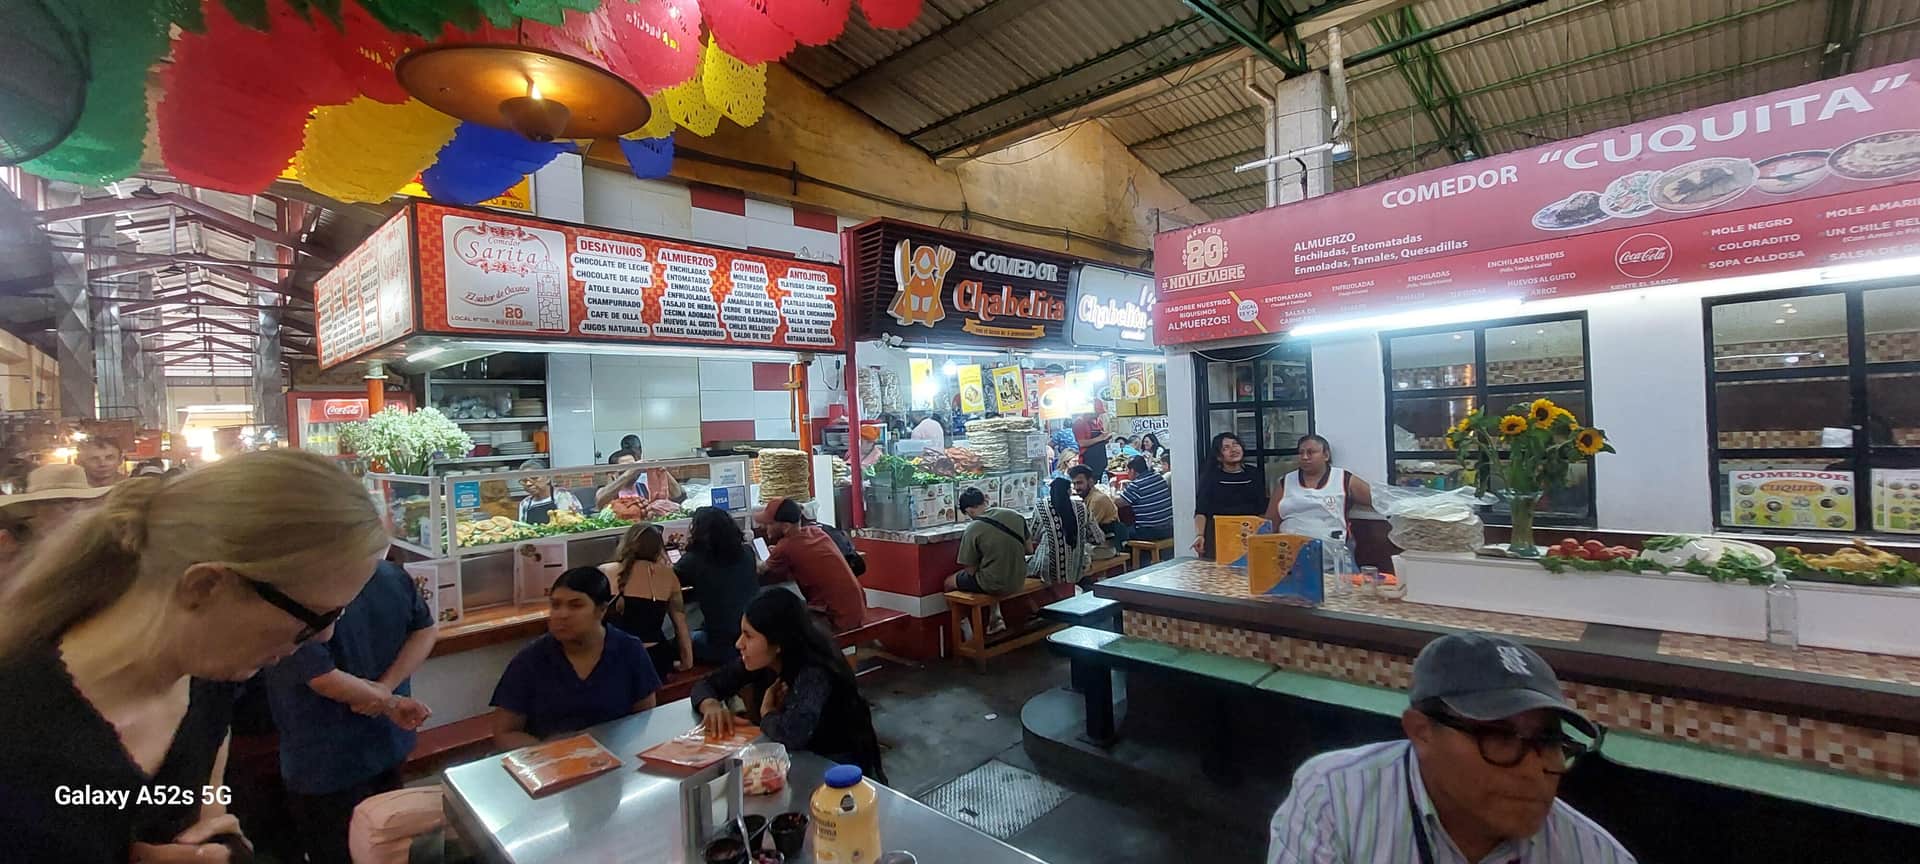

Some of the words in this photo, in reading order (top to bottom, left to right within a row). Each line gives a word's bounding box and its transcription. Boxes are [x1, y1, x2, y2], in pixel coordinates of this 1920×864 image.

[1382, 165, 1519, 209] COMEDOR
[1826, 206, 1865, 219] MOLE
[1187, 226, 1222, 240] MERCADO
[1712, 224, 1745, 236] MOLE
[1748, 218, 1792, 231] NEGRO
[1826, 227, 1846, 238] UN
[1850, 220, 1892, 234] CHILE
[1294, 232, 1356, 253] ALMUERZO
[1294, 248, 1349, 264] Enchiladas,
[1352, 233, 1422, 254] Entomatadas
[1718, 233, 1801, 252] COLORADITO
[465, 241, 536, 265] Sarita
[580, 240, 642, 258] DESAYUNOS
[1186, 235, 1223, 271] 20
[660, 252, 714, 268] ALMUERZOS
[1294, 260, 1350, 276] Enmoladas,
[1352, 252, 1399, 267] Tamales,
[1401, 240, 1469, 258] Quesadillas
[1487, 256, 1534, 268] ENCHILADAS
[1535, 251, 1565, 263] VERDES
[1618, 246, 1669, 266] Coca-Cola
[1708, 258, 1740, 270] SOPA
[1744, 250, 1806, 264] CALDOSA
[574, 256, 616, 269] CHOCOLATE
[618, 262, 626, 270] DE
[628, 264, 649, 273] LECHE
[734, 262, 765, 274] COMIDA
[970, 250, 1058, 282] COMEDOR
[670, 266, 707, 276] ENCHILADAS
[790, 270, 826, 282] ANTOJITOS
[1408, 270, 1450, 282] ENCHILADAS
[576, 270, 617, 282] CHOCOLATE
[619, 274, 628, 282] DE
[630, 276, 649, 285] AGUA
[666, 274, 710, 285] ENTOMATADAS
[733, 274, 748, 282] MOLE
[749, 275, 767, 284] NEGRO
[1170, 266, 1246, 290] NOVIEMBRE
[1508, 277, 1538, 288] HUEVOS
[1539, 276, 1548, 284] AL
[1550, 272, 1576, 282] GUSTO
[588, 284, 610, 294] ATOLE
[612, 286, 640, 296] BLANCO
[670, 283, 707, 293] ENMOLADAS
[736, 282, 764, 292] ESTOFADO
[668, 292, 711, 302] ENFRIJOLADAS
[734, 290, 767, 300] COLORADITO
[953, 280, 1064, 322] Chabelita
[1264, 292, 1313, 304] ENTOMATADAS
[588, 297, 641, 308] CHAMPURRADO
[662, 300, 686, 309] TASAJO
[688, 302, 696, 310] DE
[727, 298, 754, 307] AMARILLO
[784, 300, 806, 308] PLATILLO
[1196, 299, 1232, 310] NUESTROS
[590, 310, 609, 320] CAFE
[611, 312, 620, 320] DE
[622, 312, 639, 320] OLLA
[664, 310, 686, 318] CECINA
[724, 306, 741, 314] VERDE
[753, 309, 778, 318] ESPINAZO
[782, 308, 798, 316] SALSA
[1078, 293, 1148, 331] Chabelita
[582, 323, 606, 332] JUGOS
[608, 325, 648, 334] NATURALES
[664, 318, 688, 326] HUEVOS
[698, 320, 716, 328] GUSTO
[728, 322, 747, 330] CHILES
[1168, 315, 1231, 332] ALMUERZOS!
[656, 326, 684, 335] TAMALES
[790, 326, 806, 334] SALSA
[1737, 470, 1849, 482] COMEDOR
[1760, 482, 1825, 494] CUQUITA
